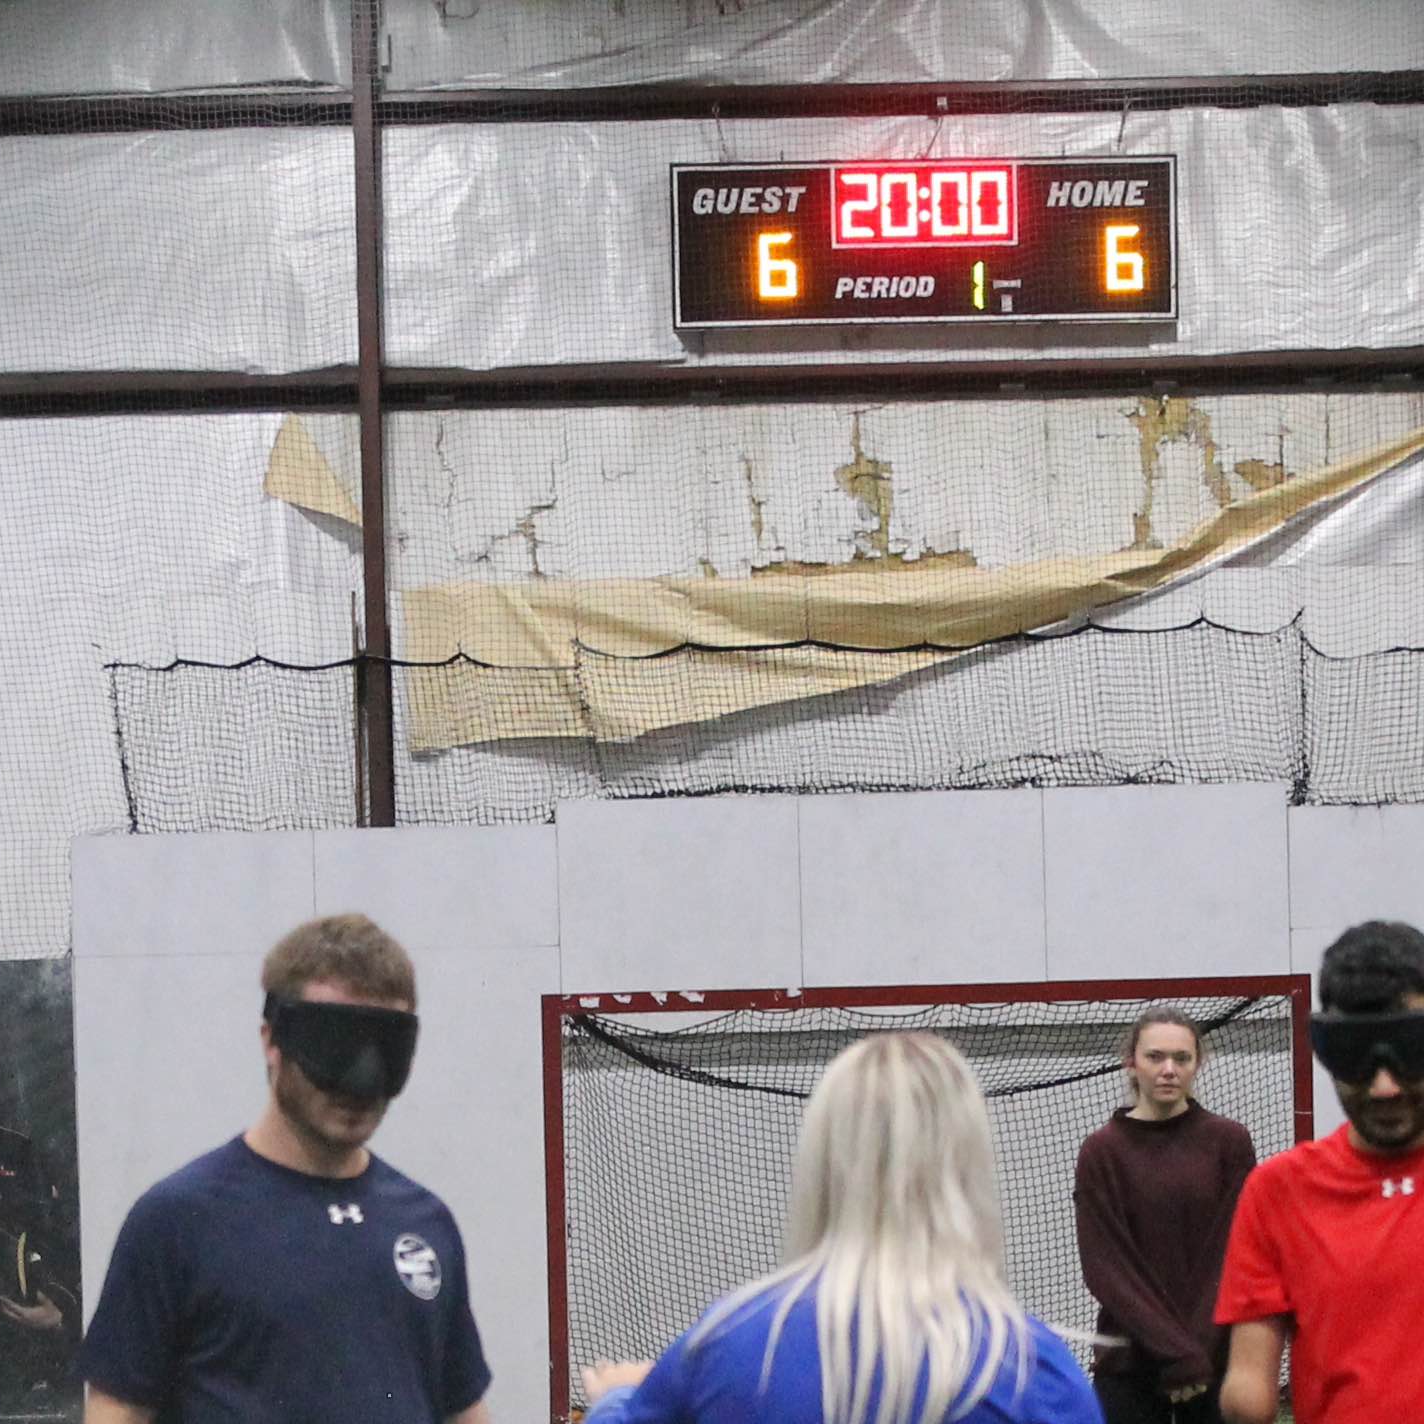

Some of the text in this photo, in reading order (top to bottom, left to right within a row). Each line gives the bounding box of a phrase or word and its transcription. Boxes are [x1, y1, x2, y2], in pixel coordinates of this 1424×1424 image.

[692, 186, 806, 215] GUEST
[841, 171, 1009, 238] 20:00
[1047, 180, 1149, 208] HOME
[758, 232, 798, 299] 6
[1106, 225, 1145, 291] 6
[835, 276, 936, 299] PERIOD
[972, 260, 985, 310] 1
